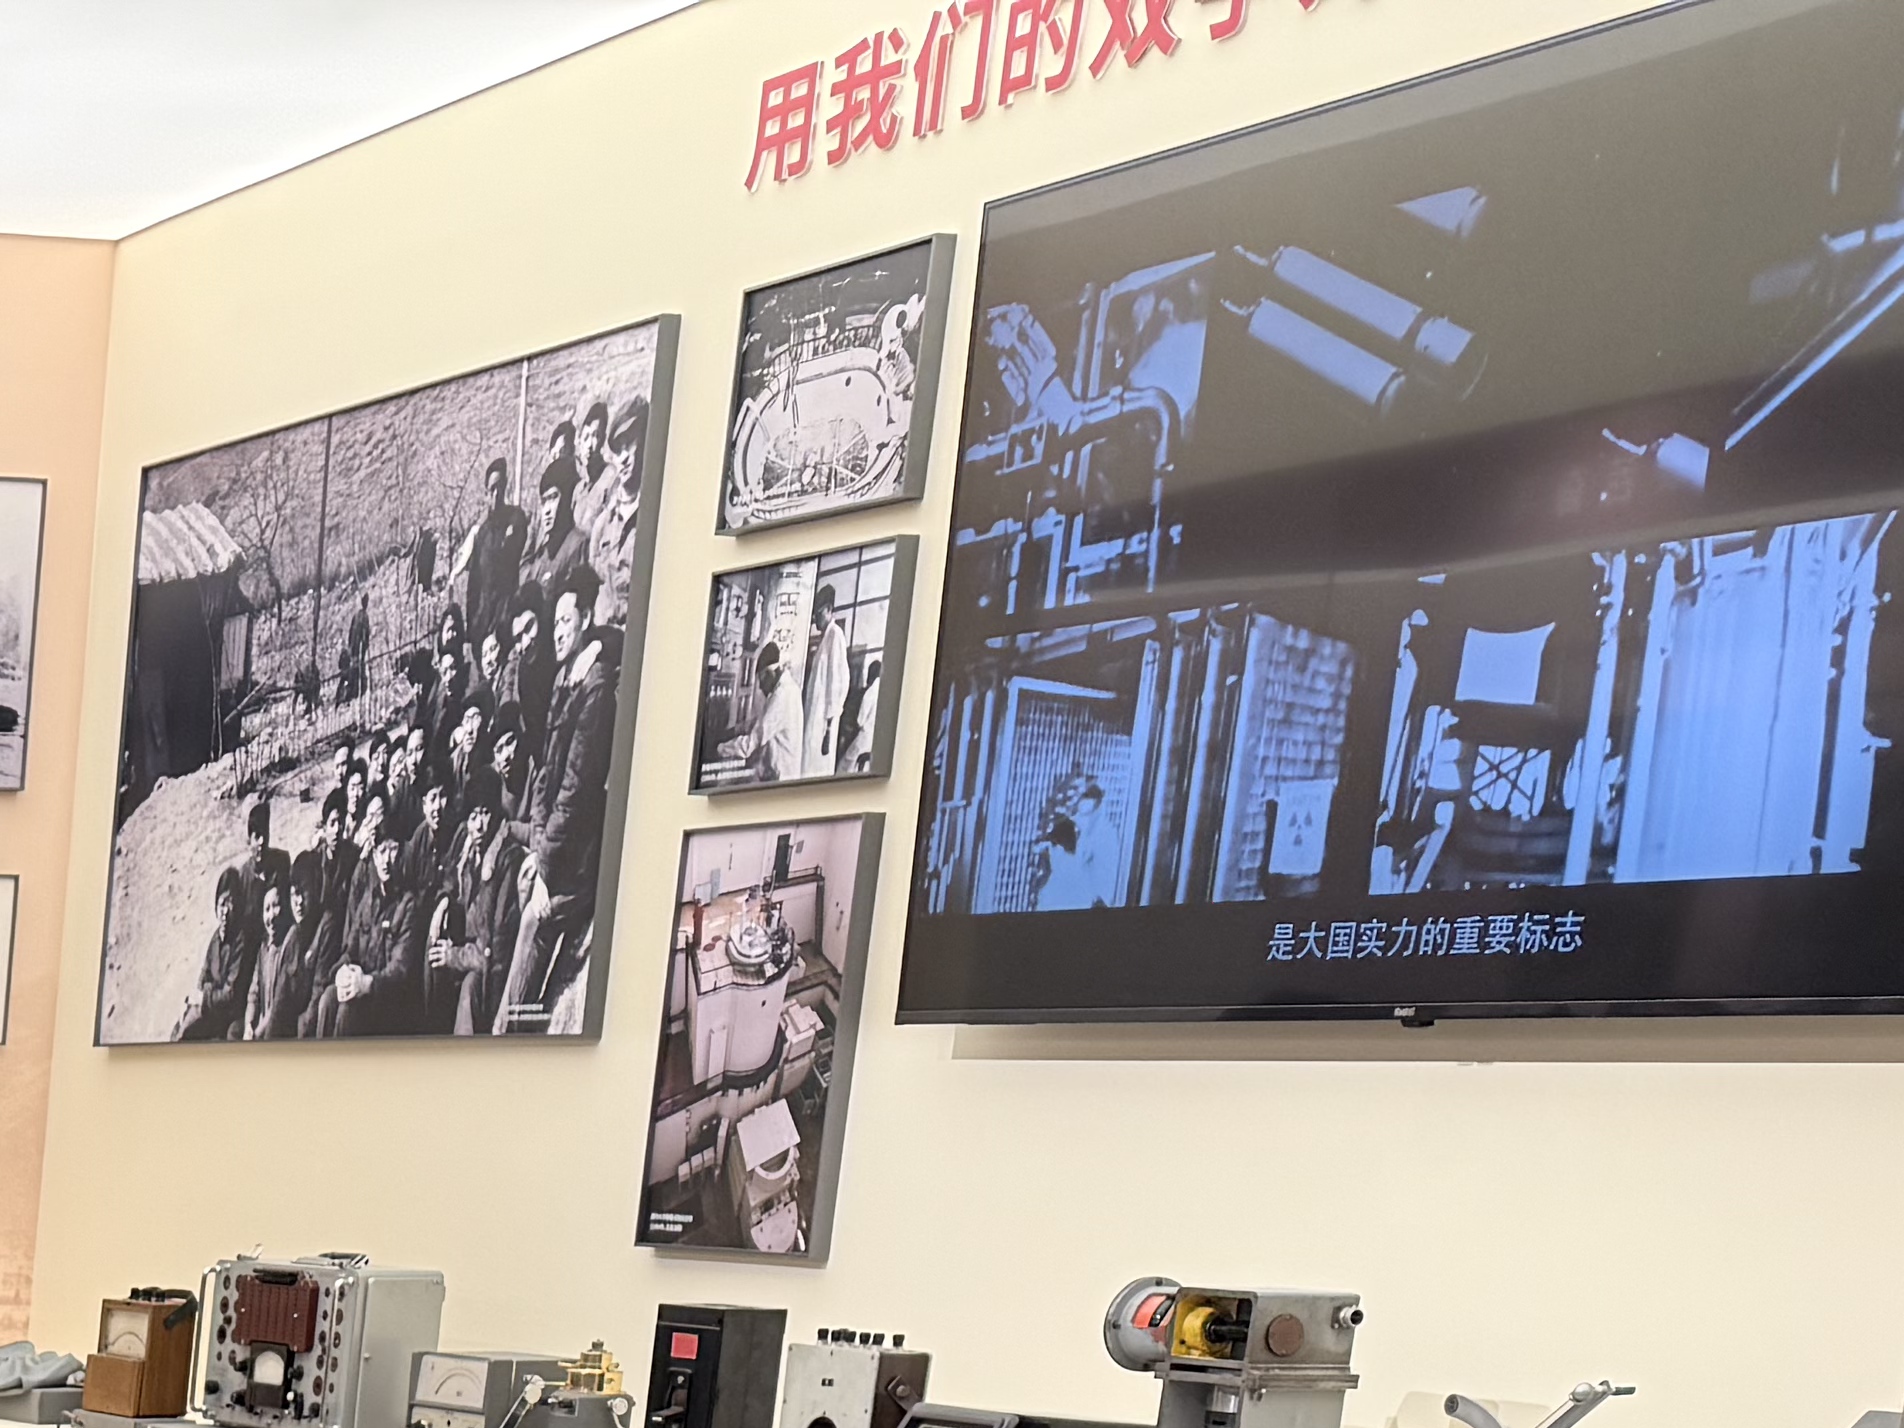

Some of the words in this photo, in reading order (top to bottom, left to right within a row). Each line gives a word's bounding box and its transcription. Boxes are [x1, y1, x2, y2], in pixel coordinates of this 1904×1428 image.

[745, 0, 1317, 192] 用我们的双
[1266, 910, 1585, 962] 是大国实力的重要标志
